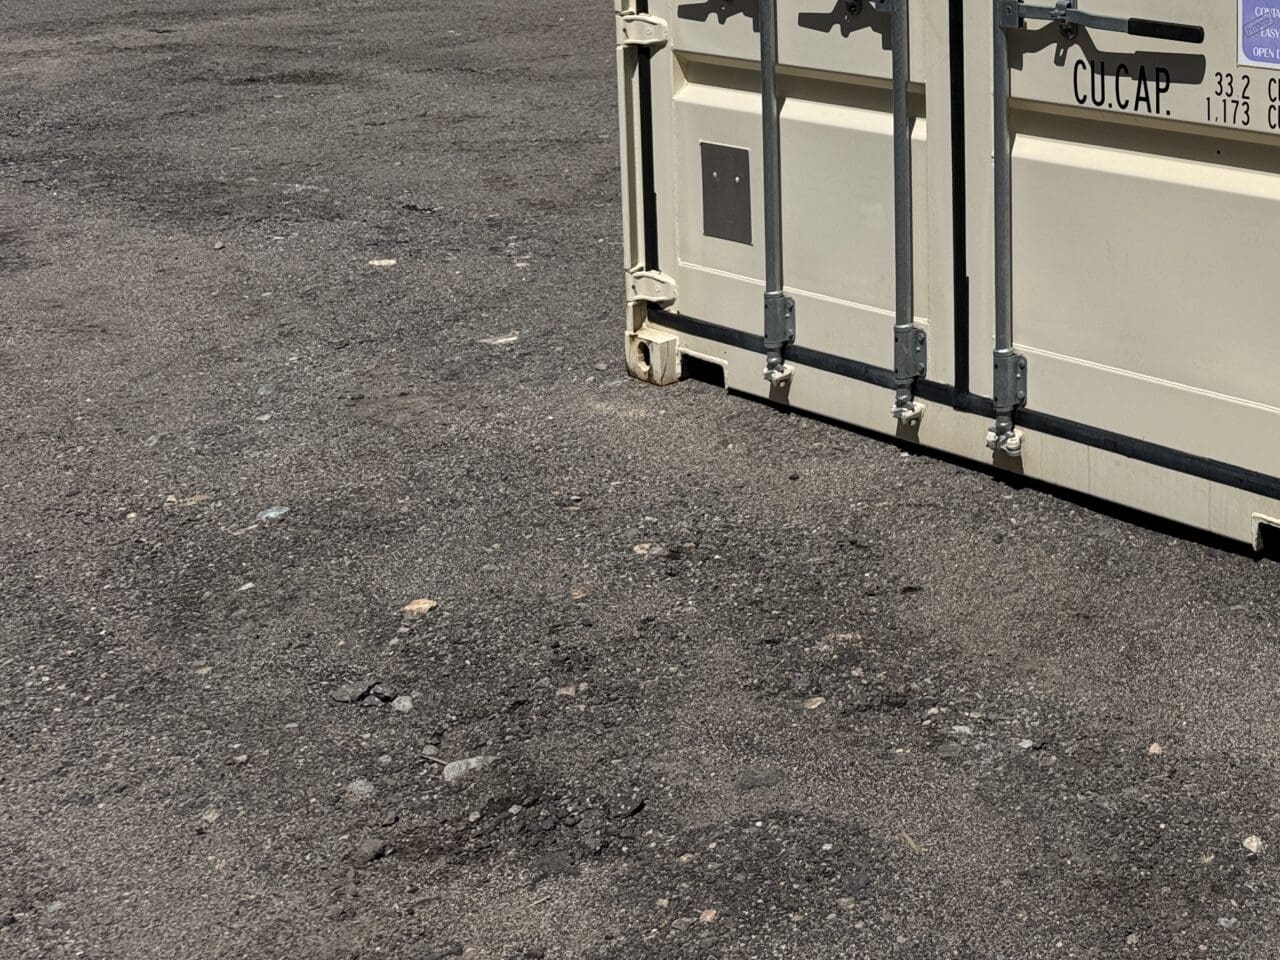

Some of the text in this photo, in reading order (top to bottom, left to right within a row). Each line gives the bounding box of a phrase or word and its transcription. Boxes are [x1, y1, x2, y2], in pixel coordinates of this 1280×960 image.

[1260, 28, 1280, 39] EASY
[1252, 47, 1275, 58] OPEN
[1073, 59, 1171, 116] CU.CAP.
[1206, 97, 1250, 125] 1,173
